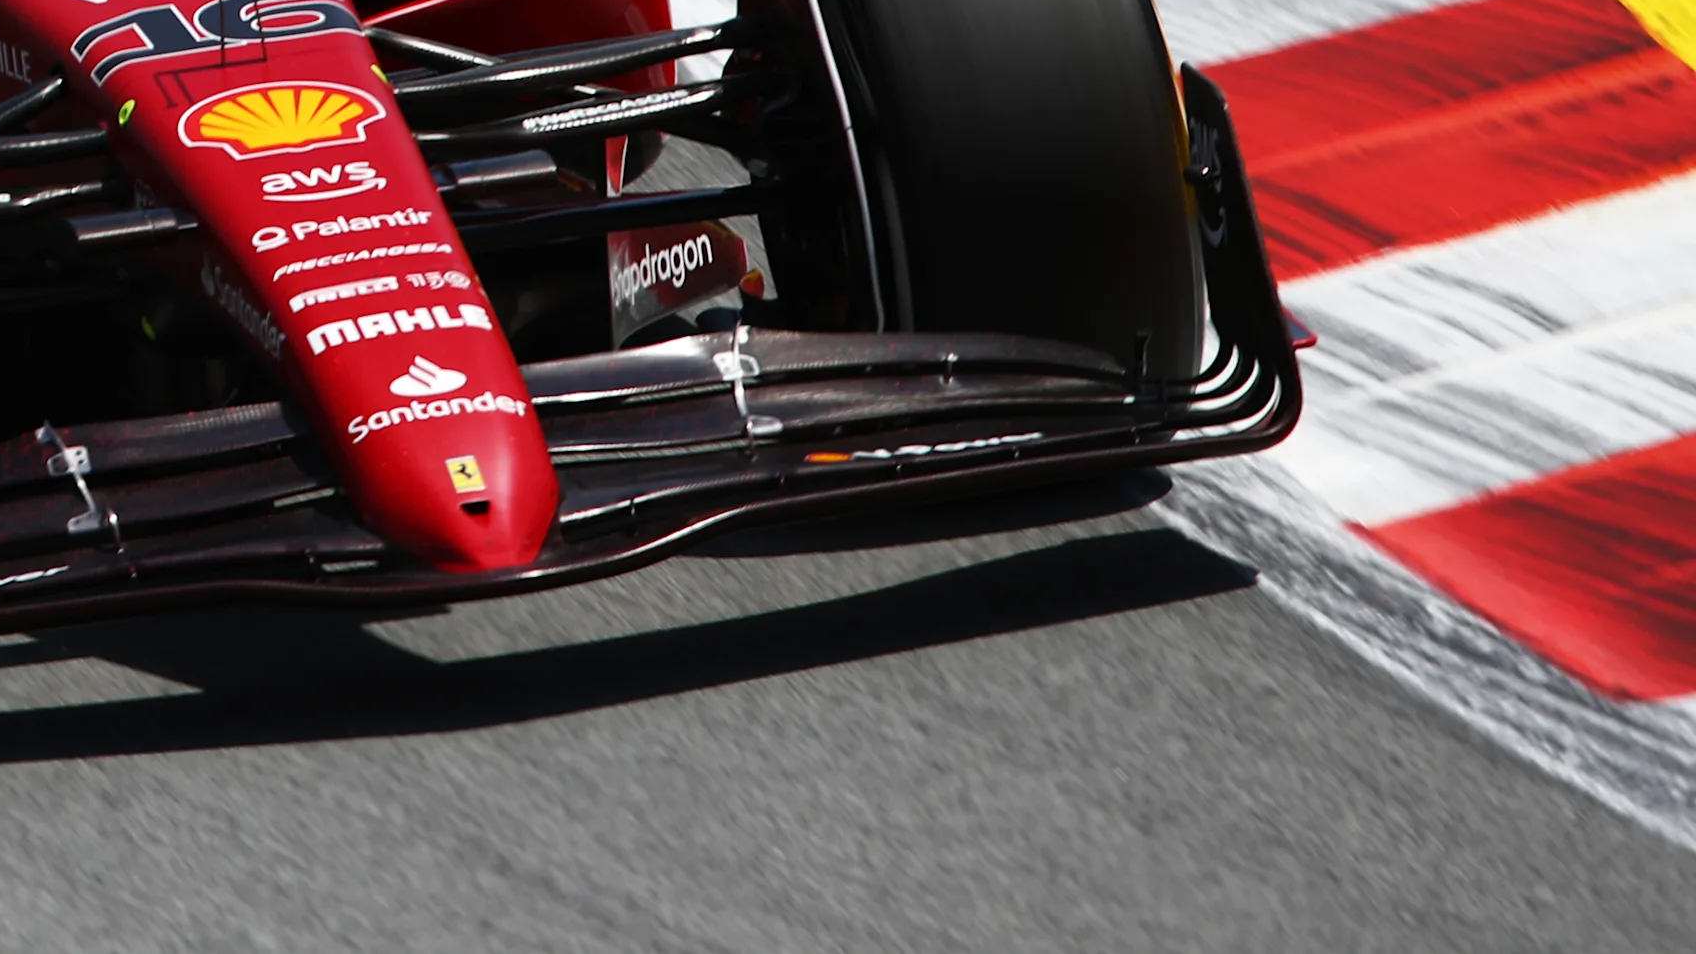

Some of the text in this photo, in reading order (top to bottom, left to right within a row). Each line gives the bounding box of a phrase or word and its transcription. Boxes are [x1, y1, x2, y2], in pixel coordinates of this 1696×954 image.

[260, 161, 377, 193] aws
[291, 207, 433, 241] Palantir
[273, 242, 453, 282] FRECCIAROSSA
[288, 275, 400, 313] PIRELLI
[306, 303, 493, 356] MAHLE
[347, 390, 527, 445] Santander
